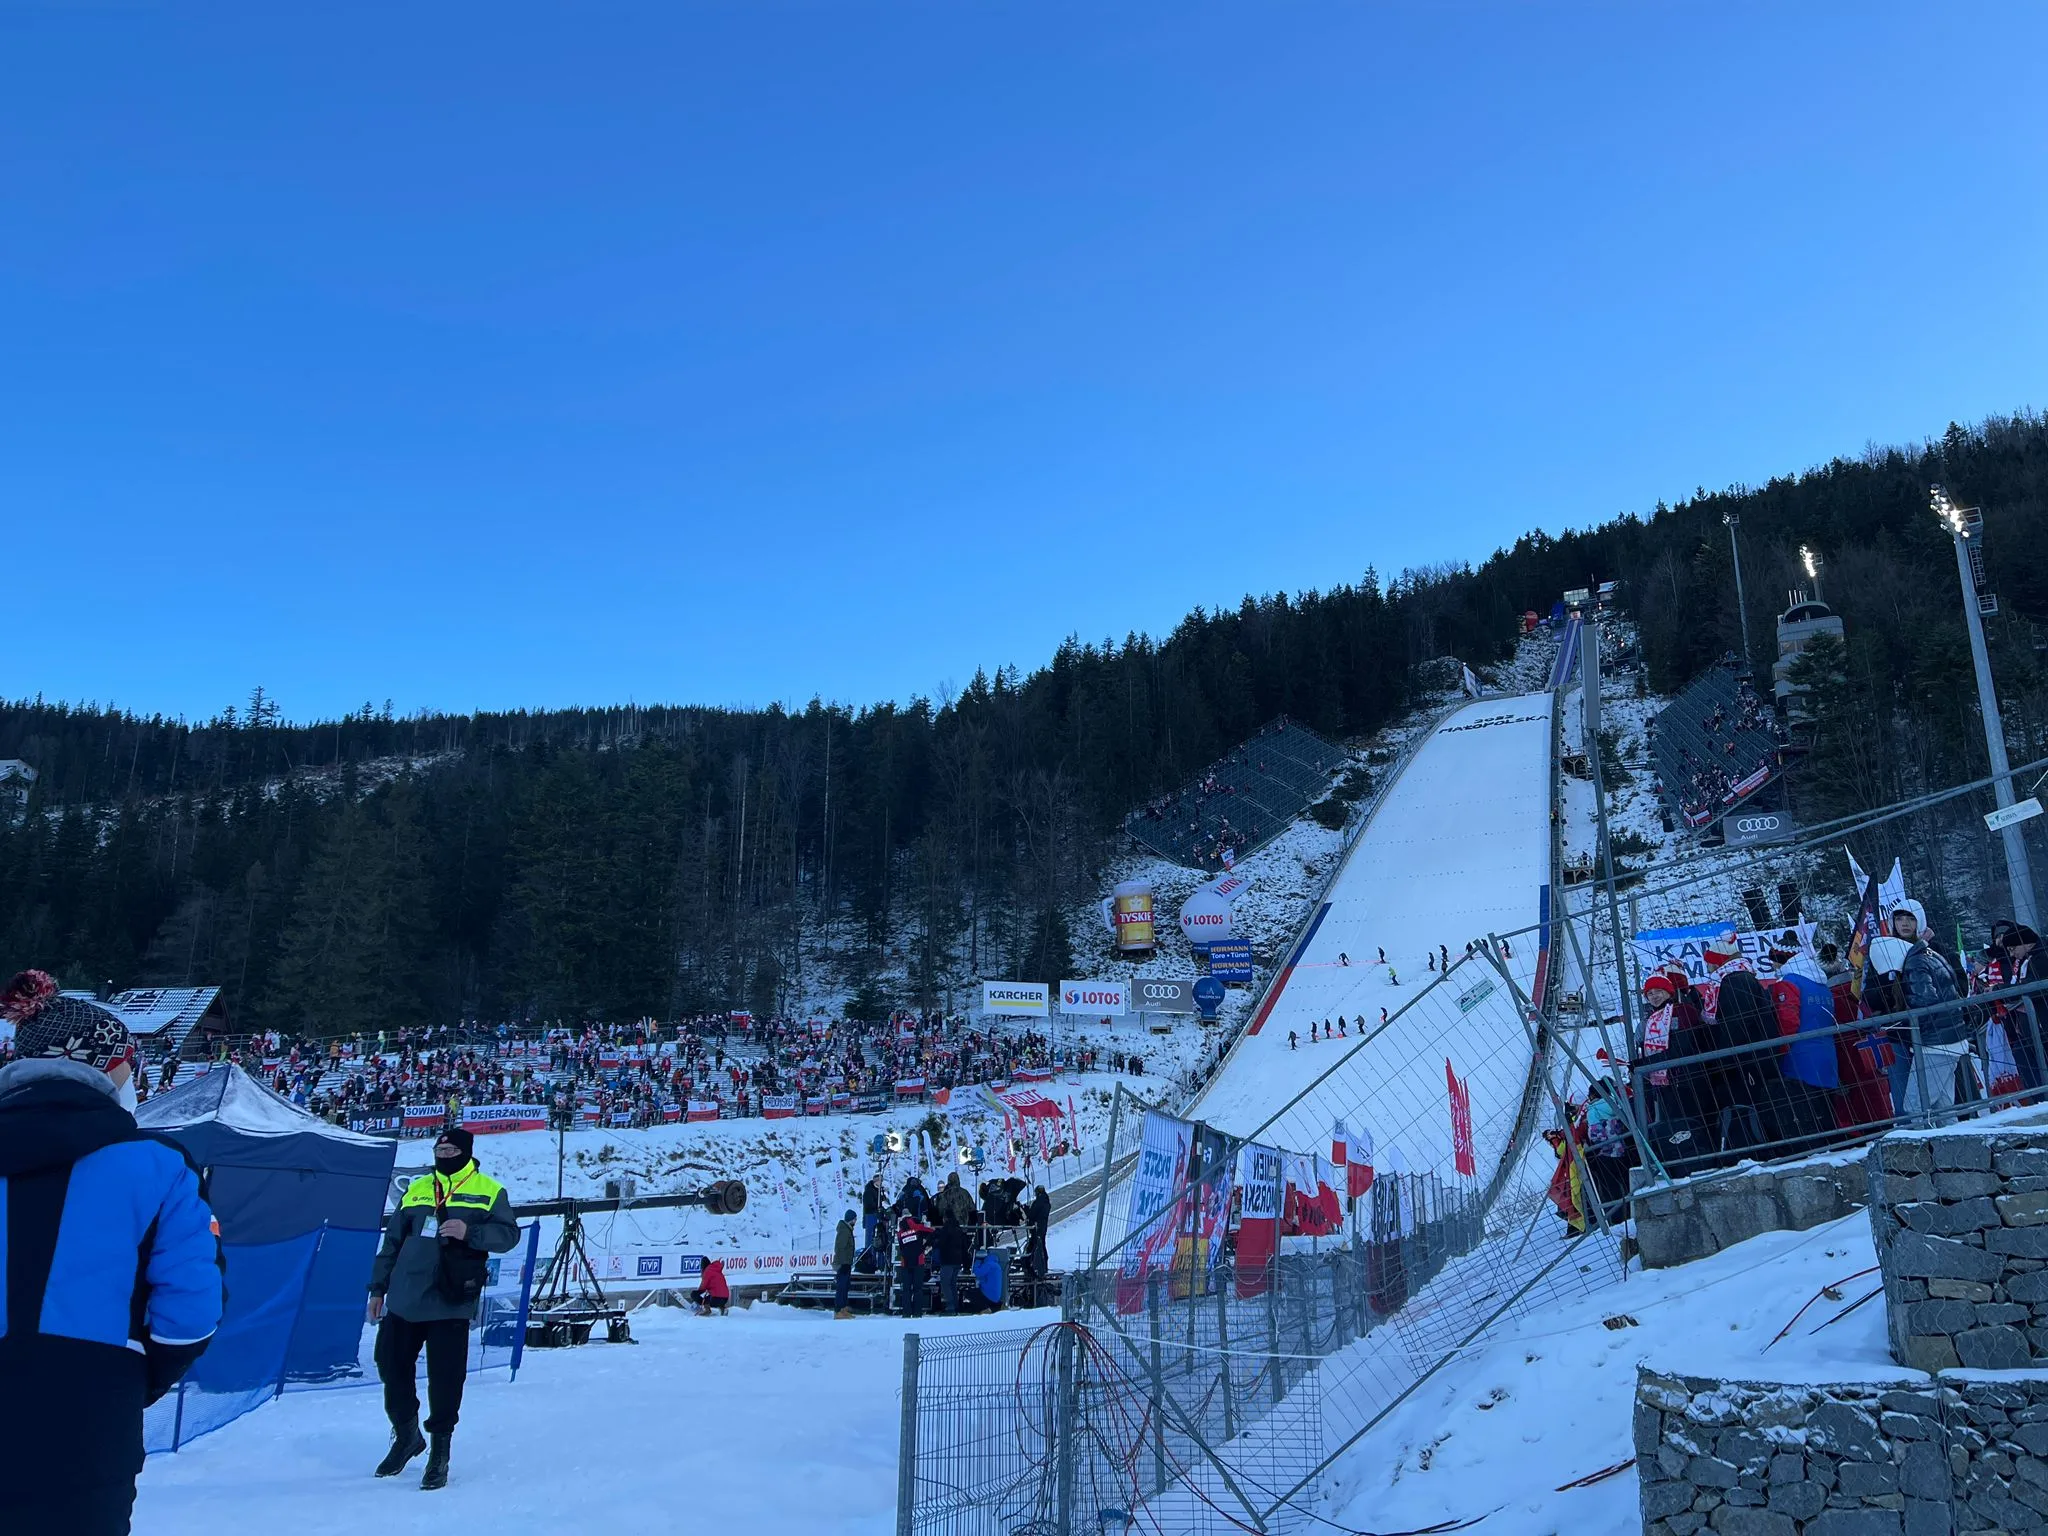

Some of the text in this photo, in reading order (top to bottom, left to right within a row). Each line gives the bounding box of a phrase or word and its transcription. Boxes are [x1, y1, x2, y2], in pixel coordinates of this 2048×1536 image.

[1119, 911, 1152, 923] TYSKIE
[1193, 914, 1224, 926] LOTOS
[1231, 951, 1250, 959] Türen
[989, 989, 1043, 1001] KÄRCHER
[1082, 991, 1120, 1005] LOTOS
[405, 1106, 444, 1116] SOWINA
[470, 1107, 541, 1120] DZIERŻANÓW
[641, 1260, 659, 1272] TVP
[726, 1257, 747, 1270] LOTOS
[763, 1256, 784, 1268] LOTOS
[798, 1255, 818, 1267] LOTOS
